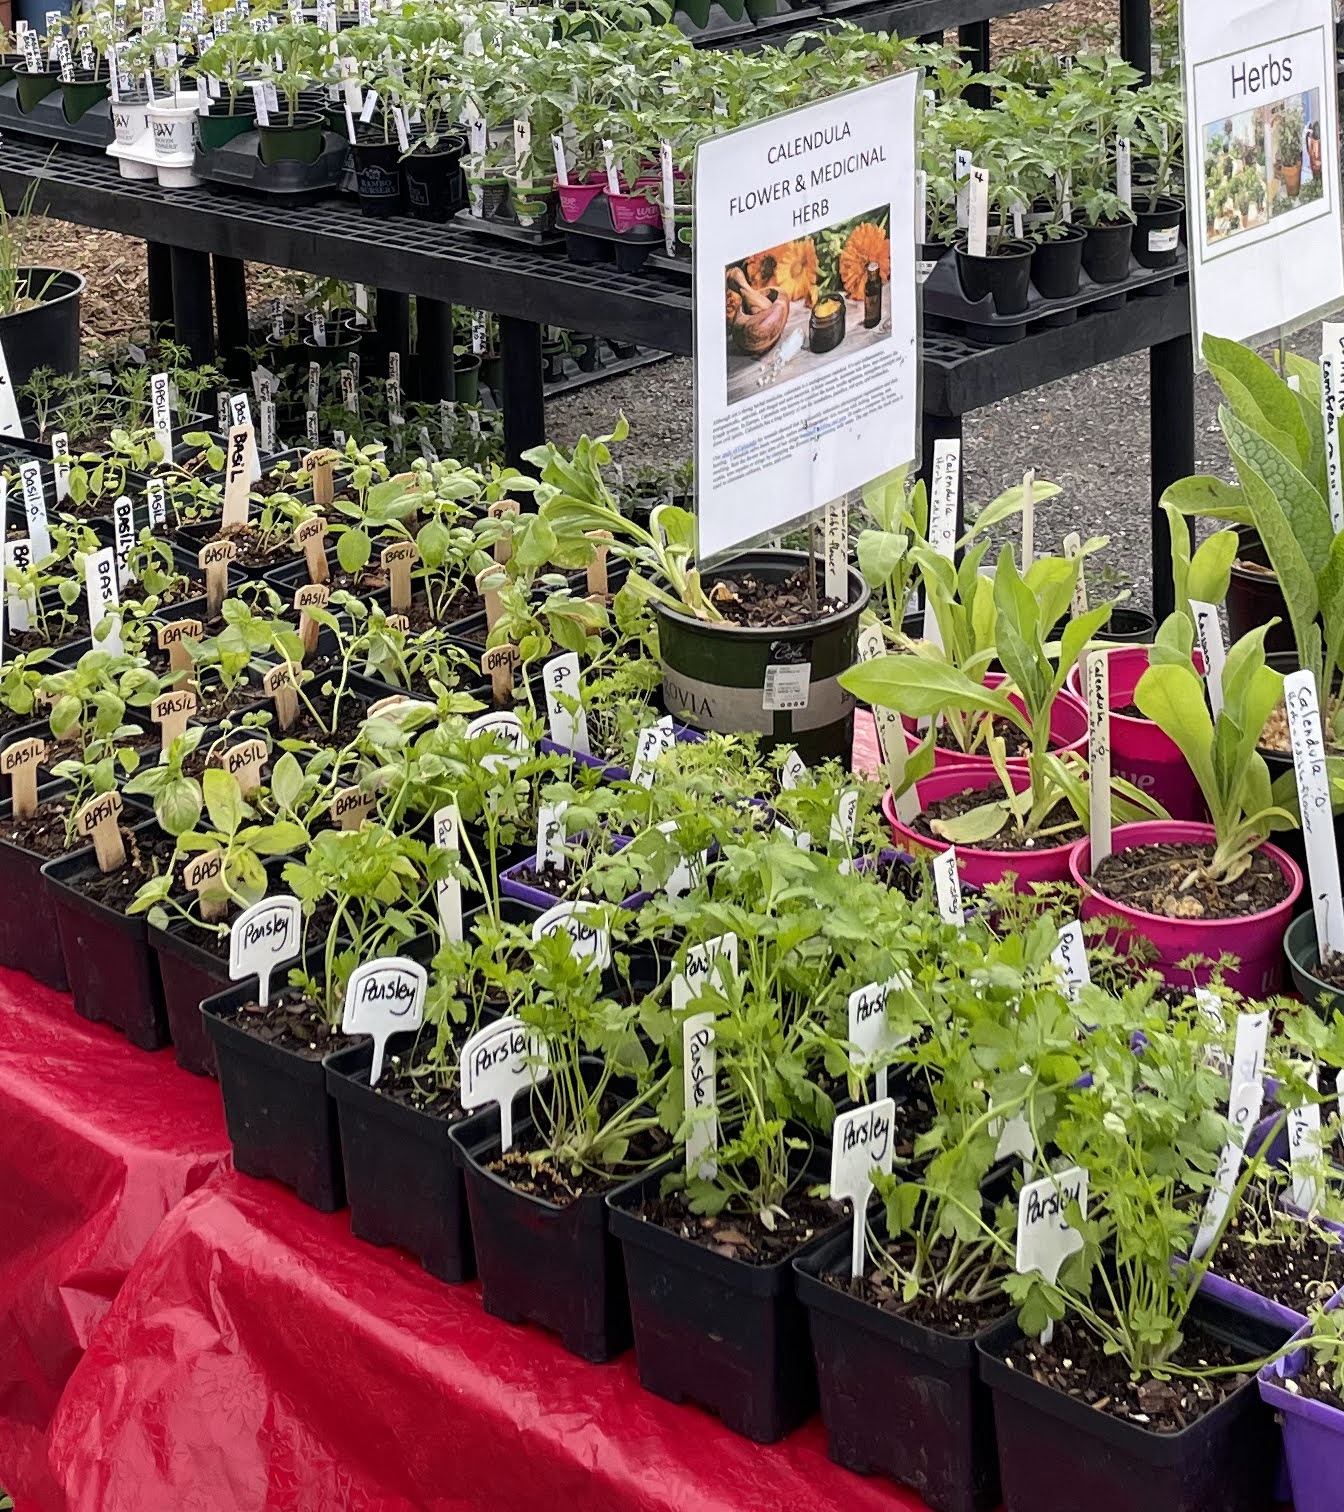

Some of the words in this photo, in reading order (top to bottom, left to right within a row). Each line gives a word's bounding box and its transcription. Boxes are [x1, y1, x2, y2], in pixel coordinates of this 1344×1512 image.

[1231, 53, 1293, 99] Herbs
[516, 123, 526, 138] 4
[767, 121, 851, 164] CALENDULA
[1118, 139, 1126, 151] 4
[957, 155, 967, 166] 4
[974, 170, 985, 183] 4
[729, 179, 791, 216] FLOWER
[794, 174, 806, 192] &
[810, 145, 887, 186] MEDICINAL
[792, 198, 829, 227] HERB
[154, 379, 167, 423] BASIL
[230, 431, 248, 484] BASIL
[945, 453, 957, 516] Calendula
[117, 503, 134, 547] BASIL
[204, 547, 237, 564] BASIL
[385, 548, 416, 564] BASIL
[97, 560, 114, 606] BAS
[299, 588, 329, 606] BASIL
[162, 625, 203, 645] BASIL
[487, 651, 521, 671] BASIL
[156, 694, 196, 717] BASIL
[1093, 658, 1105, 728] Calendula
[1297, 686, 1321, 777] Calendula
[5, 742, 44, 768] BASIL
[229, 747, 266, 773] BASIL
[83, 797, 123, 829] BASIL
[335, 792, 374, 816] BASIL
[946, 858, 958, 915] Parsley
[243, 913, 289, 952] Parsley
[361, 975, 416, 1016] Parsley
[842, 1110, 890, 1161] Parsley
